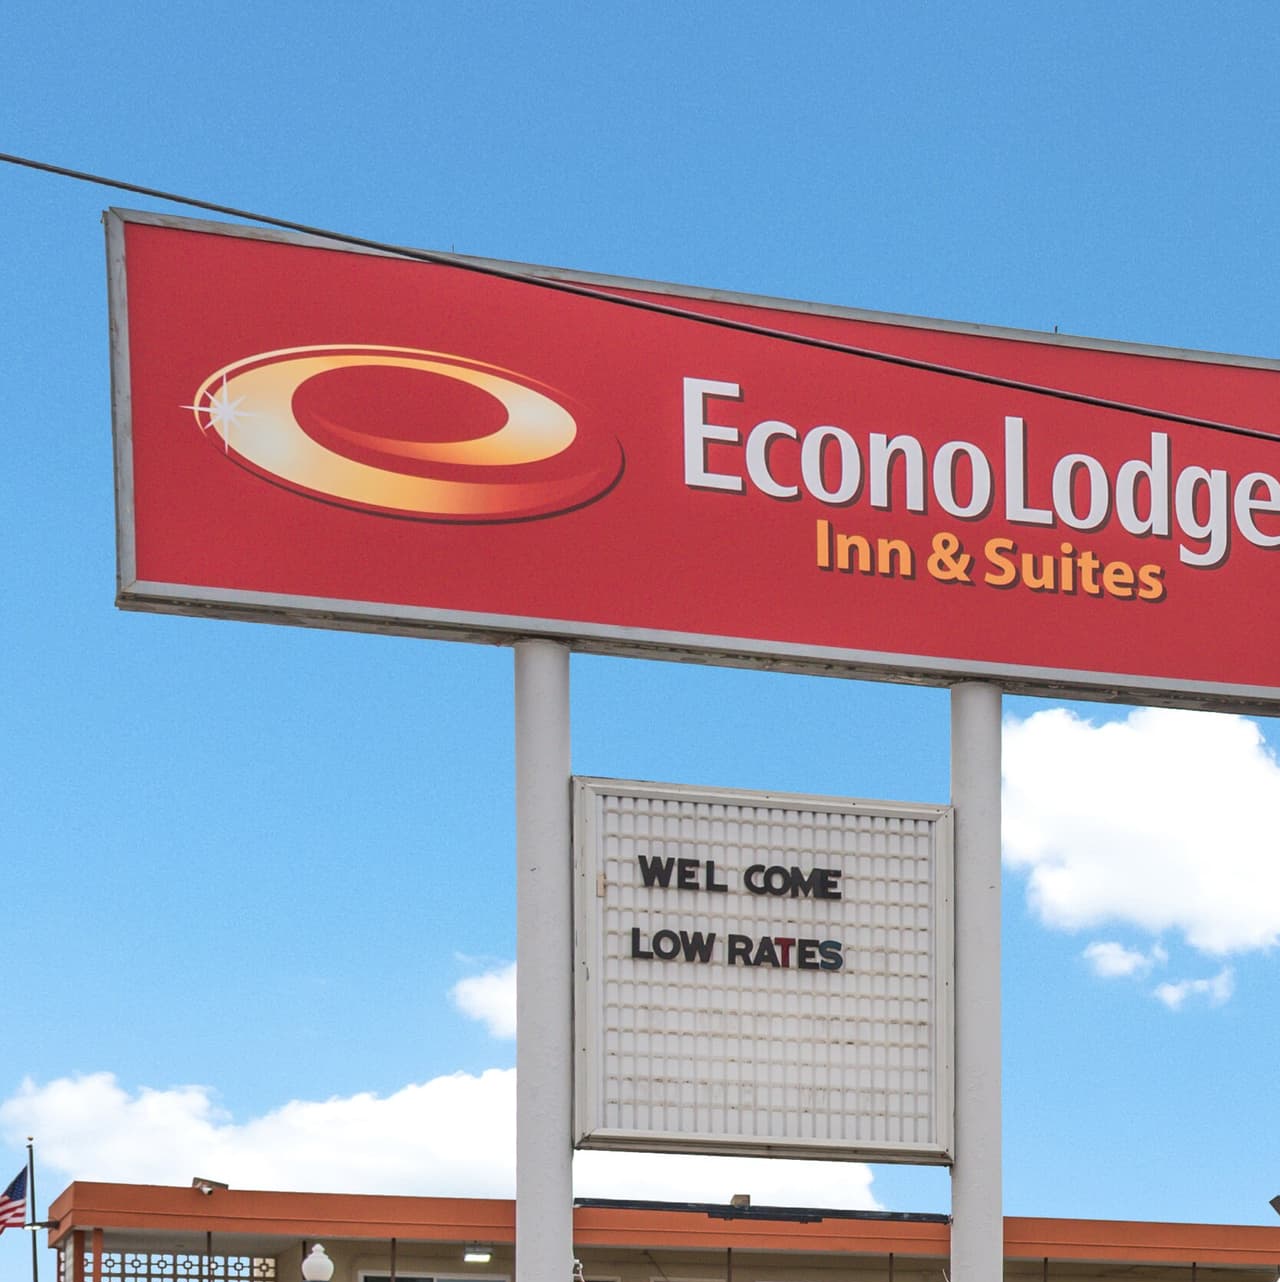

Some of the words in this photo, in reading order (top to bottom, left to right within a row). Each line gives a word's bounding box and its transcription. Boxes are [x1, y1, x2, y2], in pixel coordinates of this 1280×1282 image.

[816, 519, 914, 578] Inn
[926, 531, 973, 583] &
[983, 538, 1166, 601] Suites
[631, 927, 717, 964] LOW
[727, 933, 844, 970] RATES
